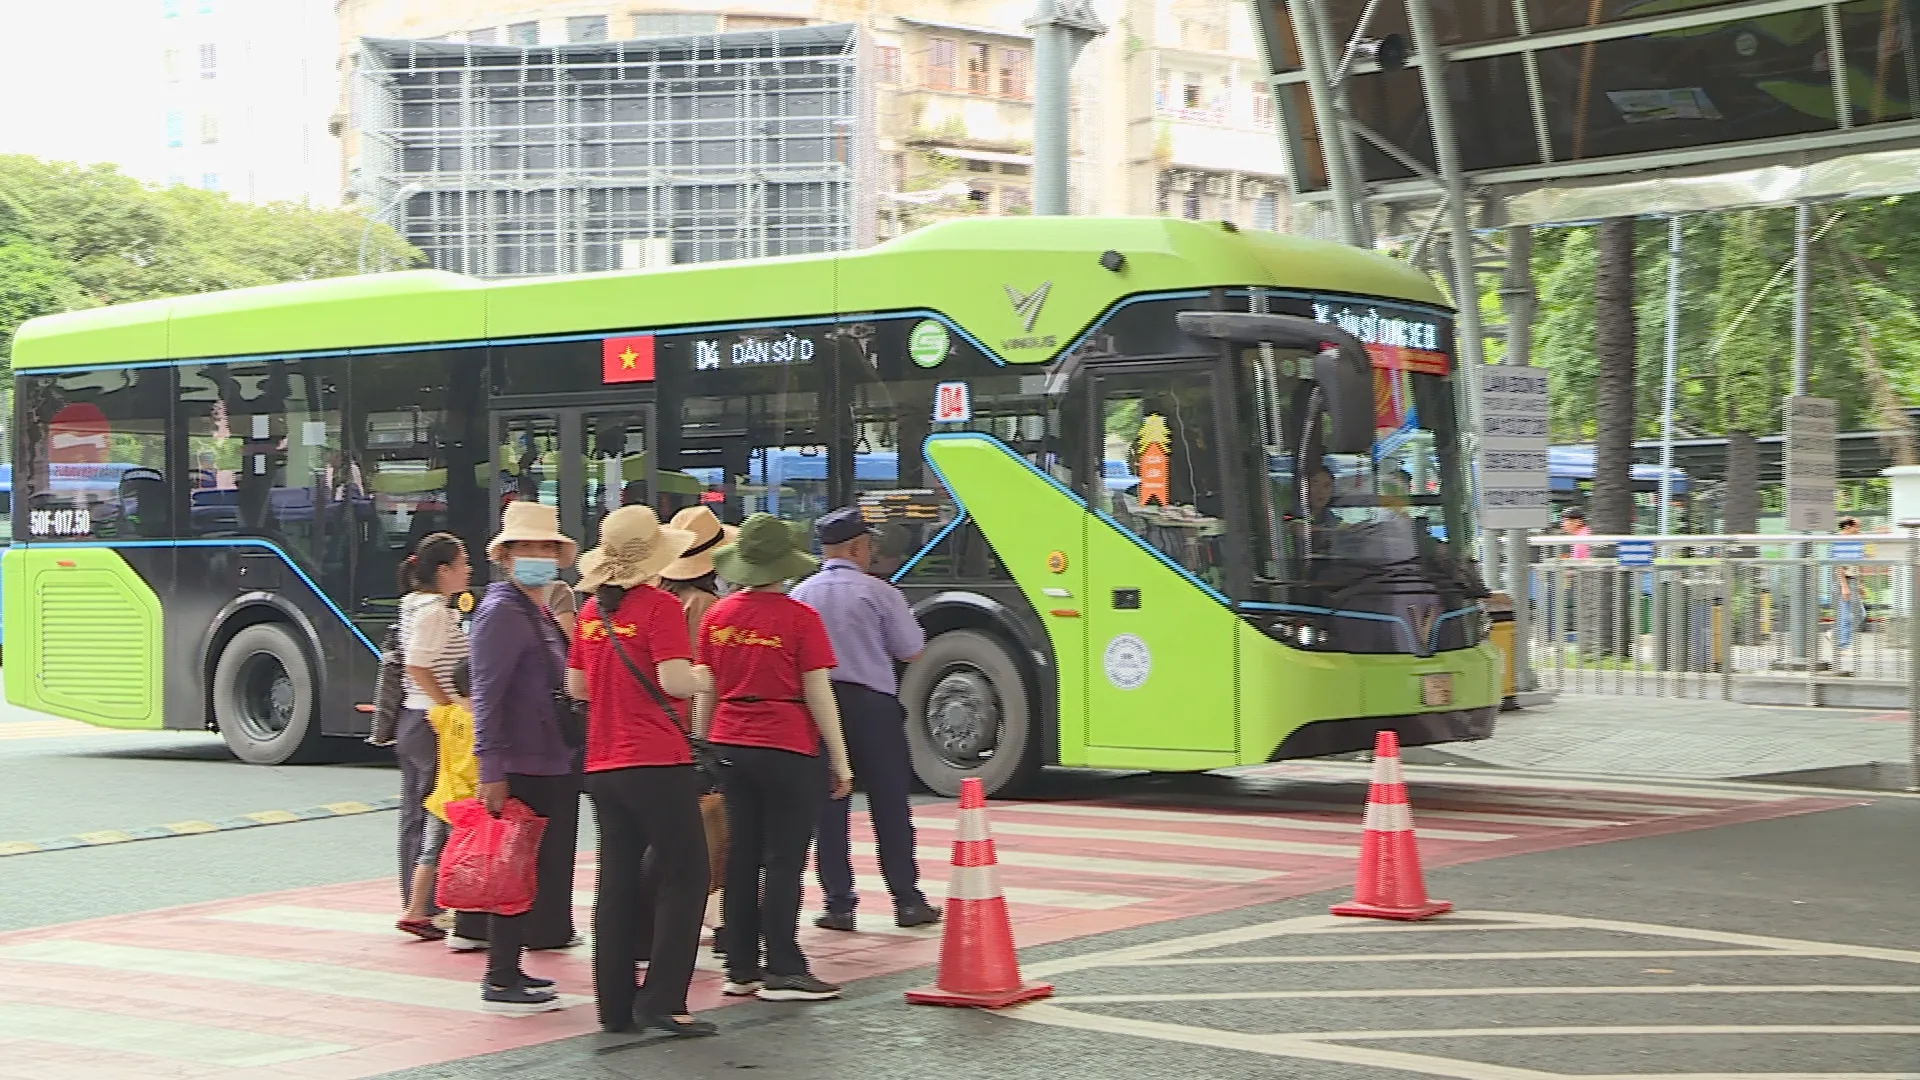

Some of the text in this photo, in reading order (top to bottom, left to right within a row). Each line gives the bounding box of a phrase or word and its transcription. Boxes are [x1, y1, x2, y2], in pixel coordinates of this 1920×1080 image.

[1408, 321, 1424, 348] XE
[696, 340, 720, 370] D4
[732, 337, 769, 365] DÂN
[800, 339, 814, 361] D
[941, 387, 962, 418] D4
[30, 509, 90, 535] 50F-017.50
